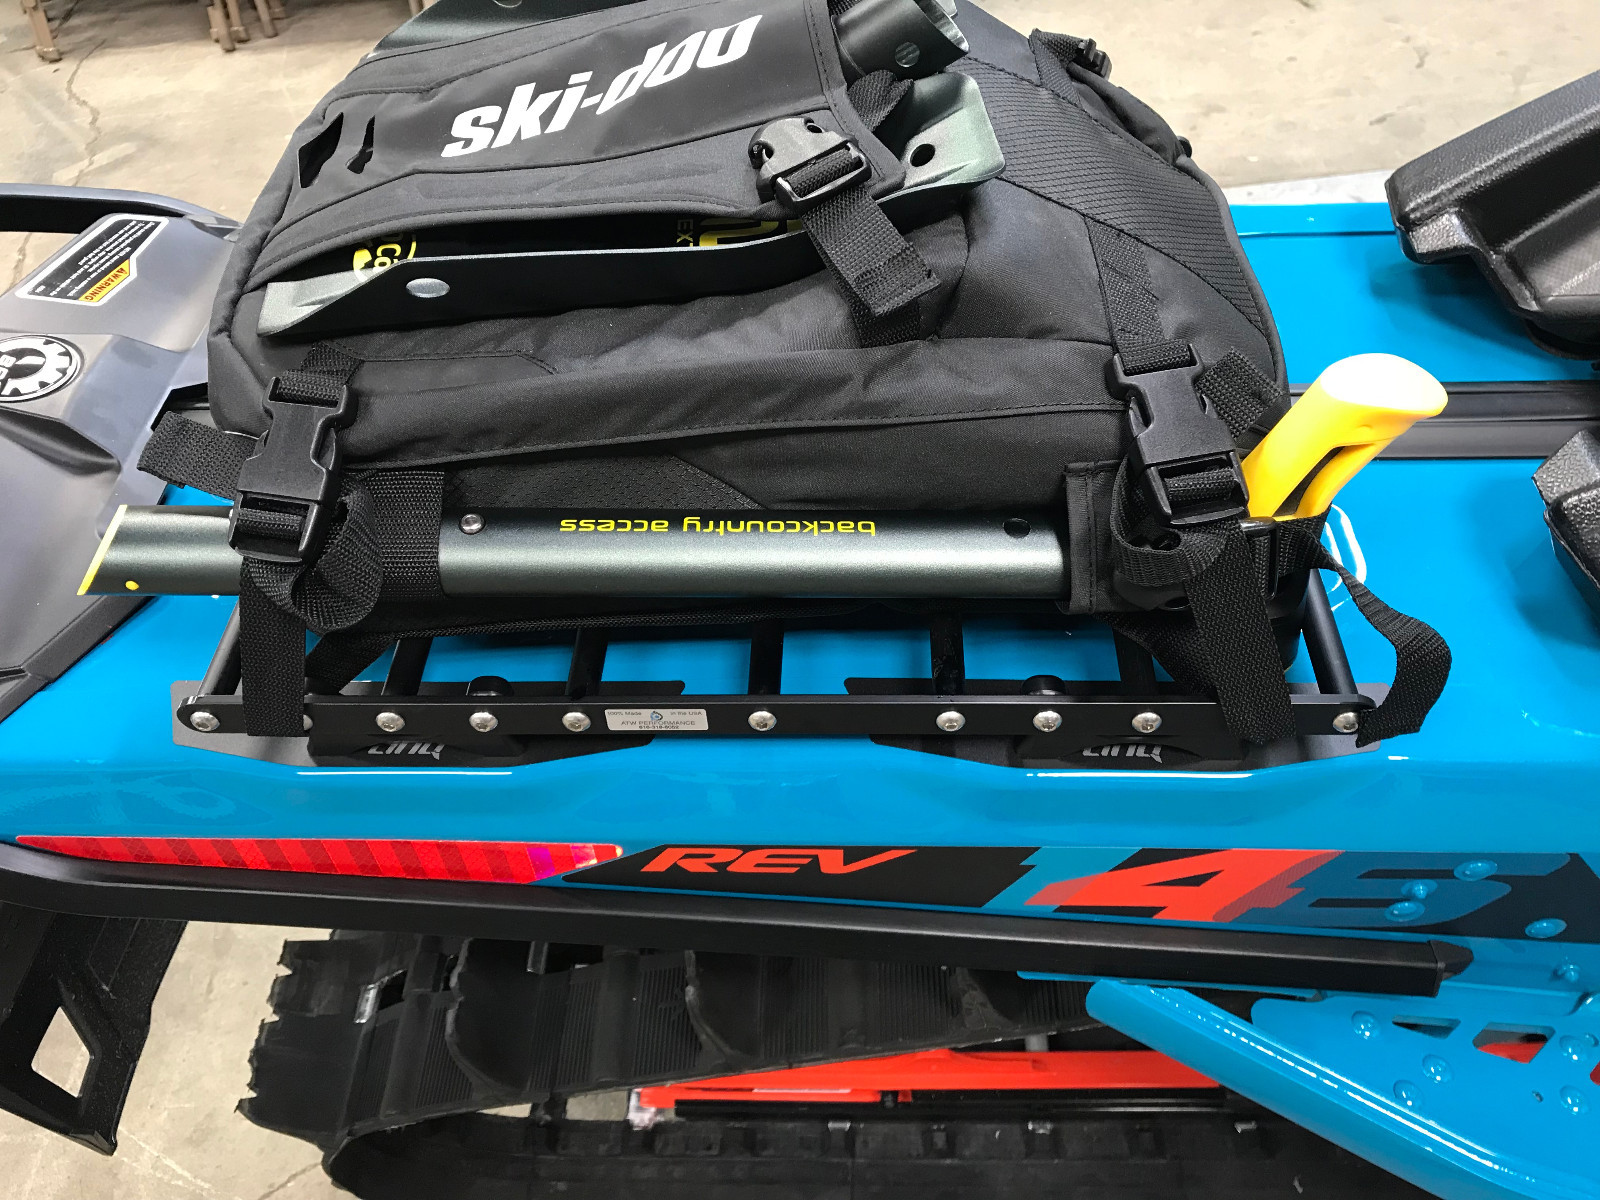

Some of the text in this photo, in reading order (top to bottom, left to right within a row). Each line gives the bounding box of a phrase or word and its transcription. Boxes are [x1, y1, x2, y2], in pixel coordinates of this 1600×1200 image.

[441, 15, 763, 157] ski-doo
[84, 271, 122, 302] WARNING
[559, 516, 876, 536] backcountry access
[640, 847, 918, 874] REV
